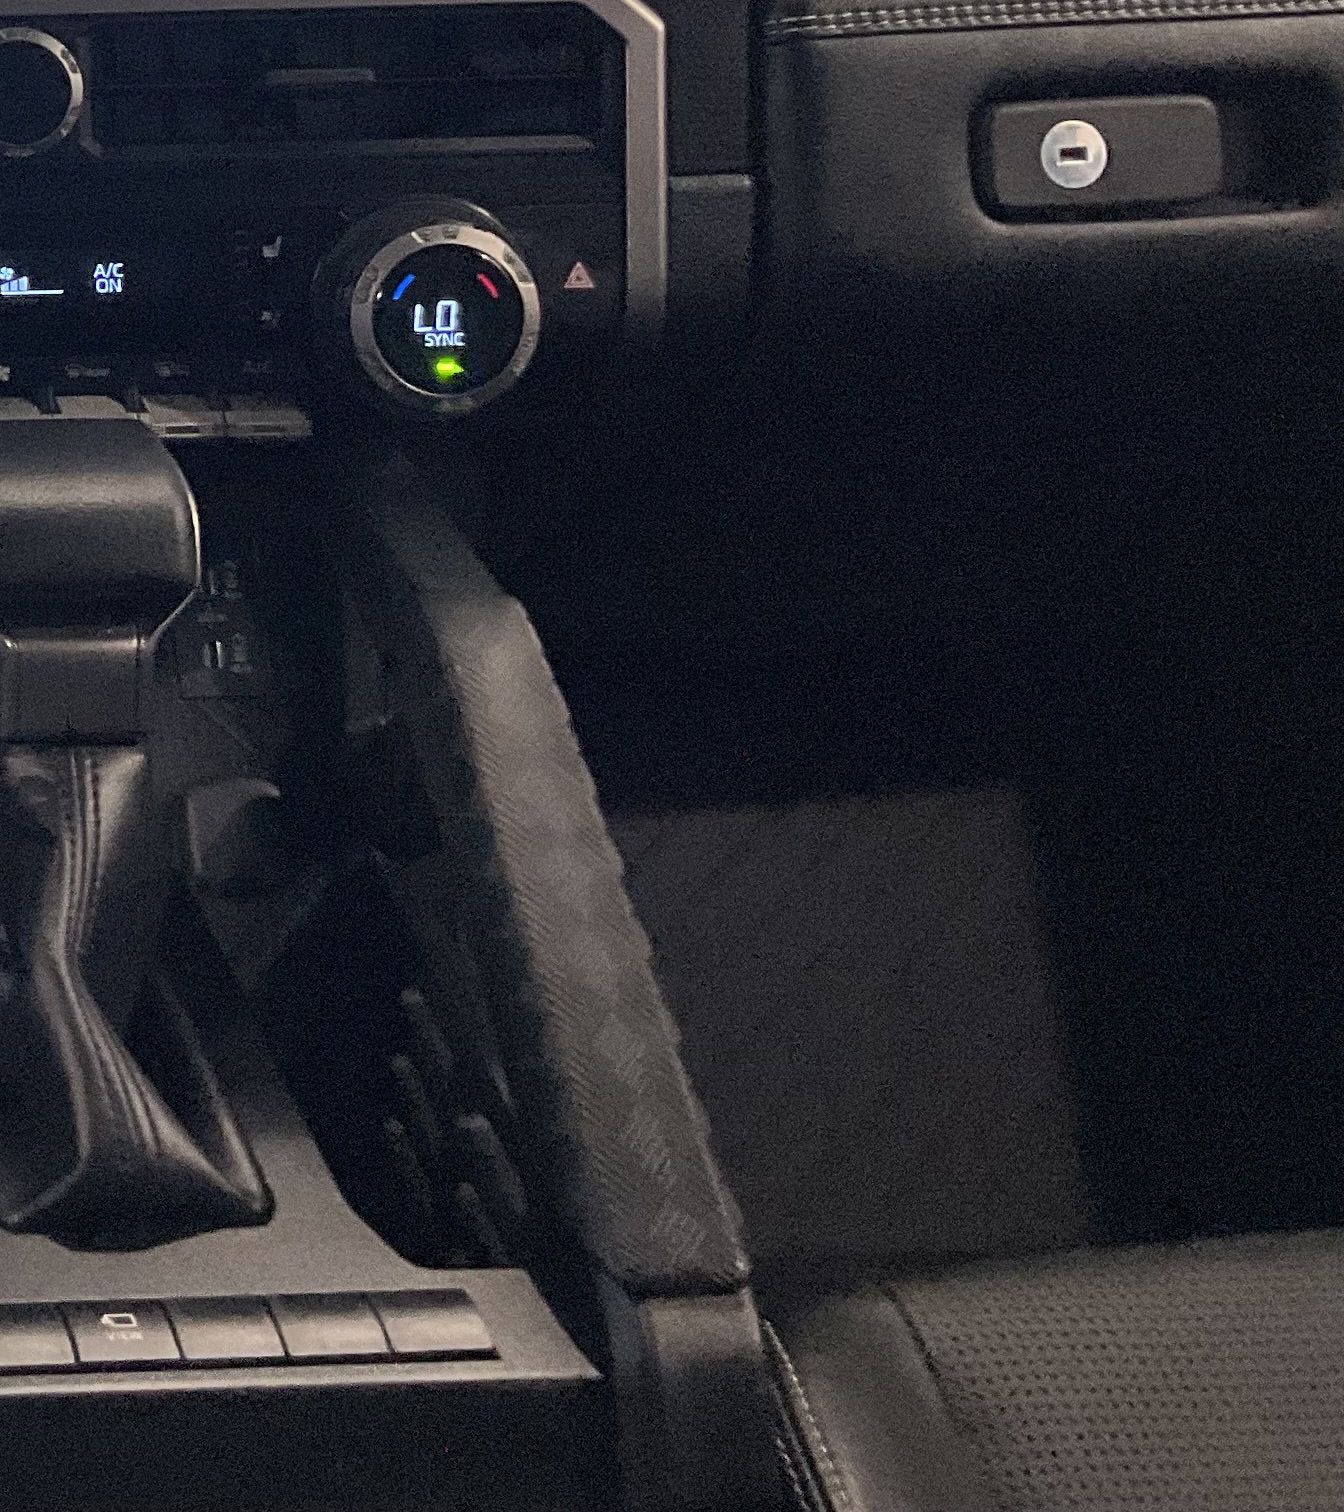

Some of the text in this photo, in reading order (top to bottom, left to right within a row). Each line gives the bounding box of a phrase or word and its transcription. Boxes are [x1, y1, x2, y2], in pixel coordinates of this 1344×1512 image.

[93, 262, 124, 278] A/C
[95, 278, 123, 294] ON
[424, 332, 466, 347] SYNC
